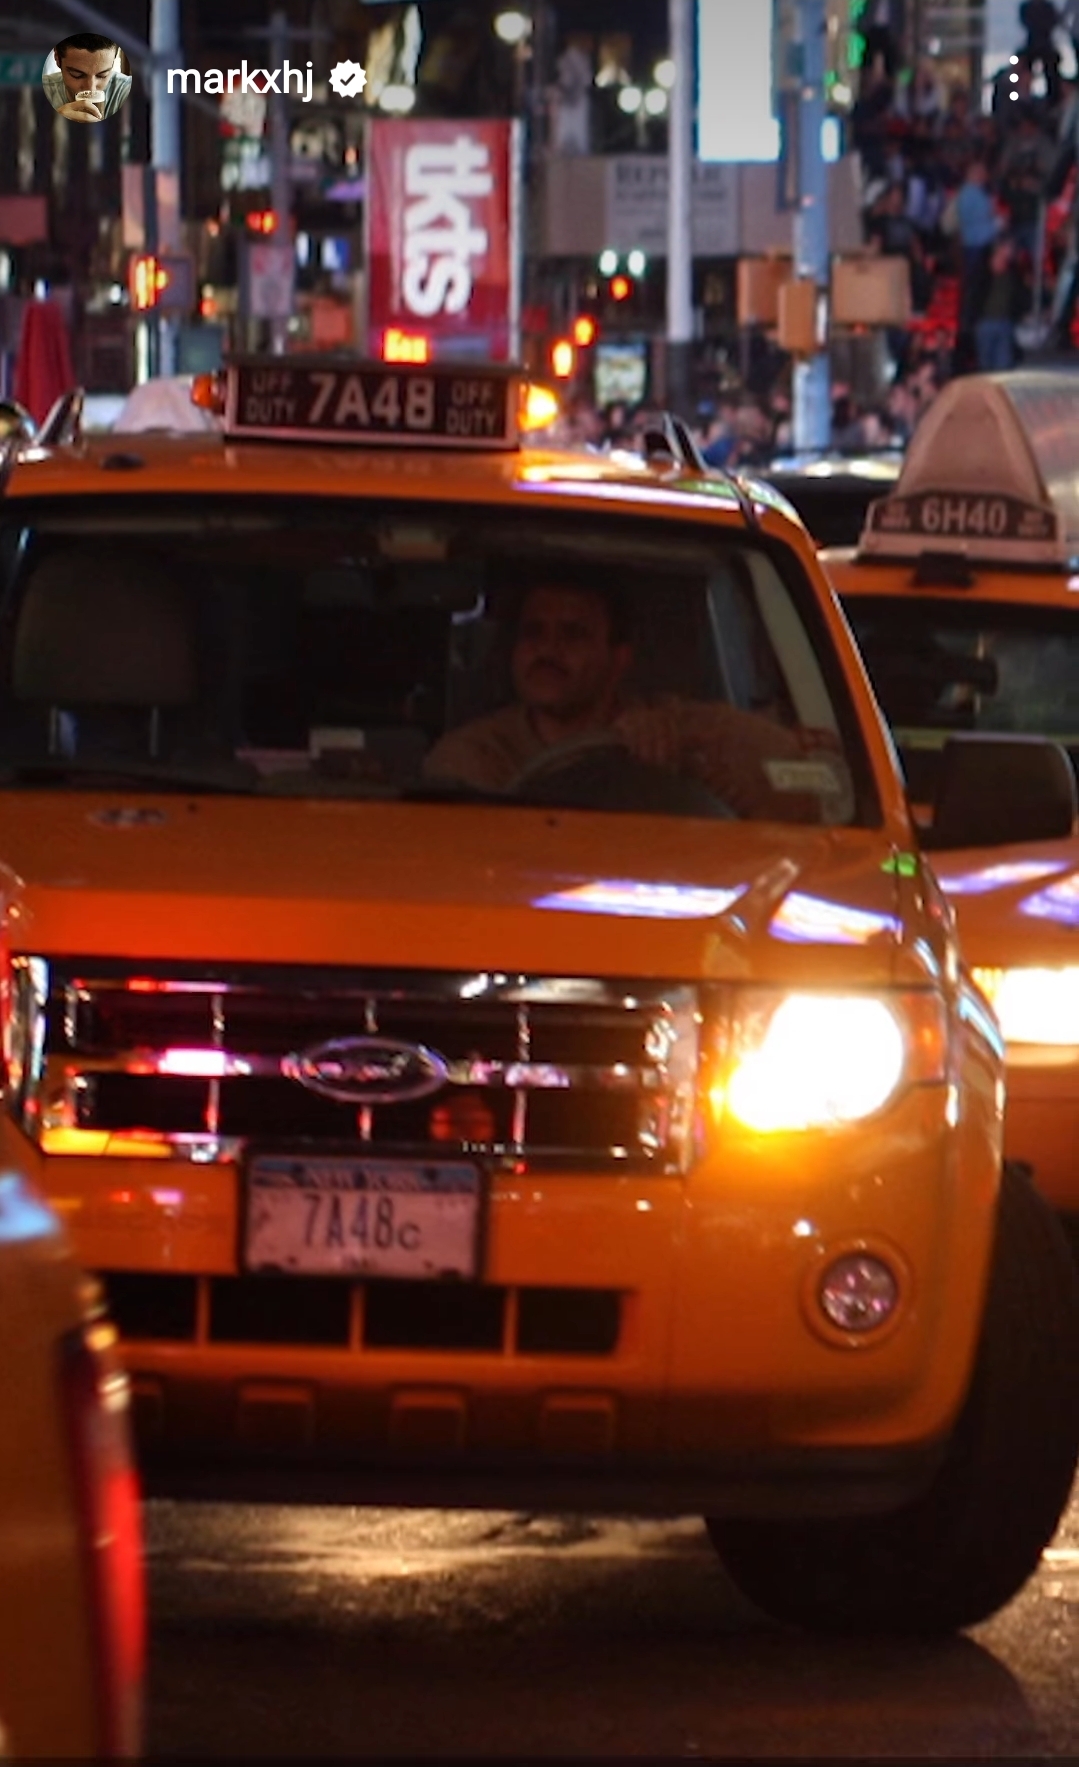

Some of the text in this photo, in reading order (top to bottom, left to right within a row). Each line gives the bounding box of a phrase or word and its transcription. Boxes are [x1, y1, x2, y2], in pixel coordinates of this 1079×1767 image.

[403, 135, 494, 317] tkts
[308, 372, 435, 430] 7A48
[451, 380, 494, 405] OFF
[245, 398, 297, 424] DUTY
[446, 408, 498, 436] DUTY
[921, 497, 1008, 534] 6H40
